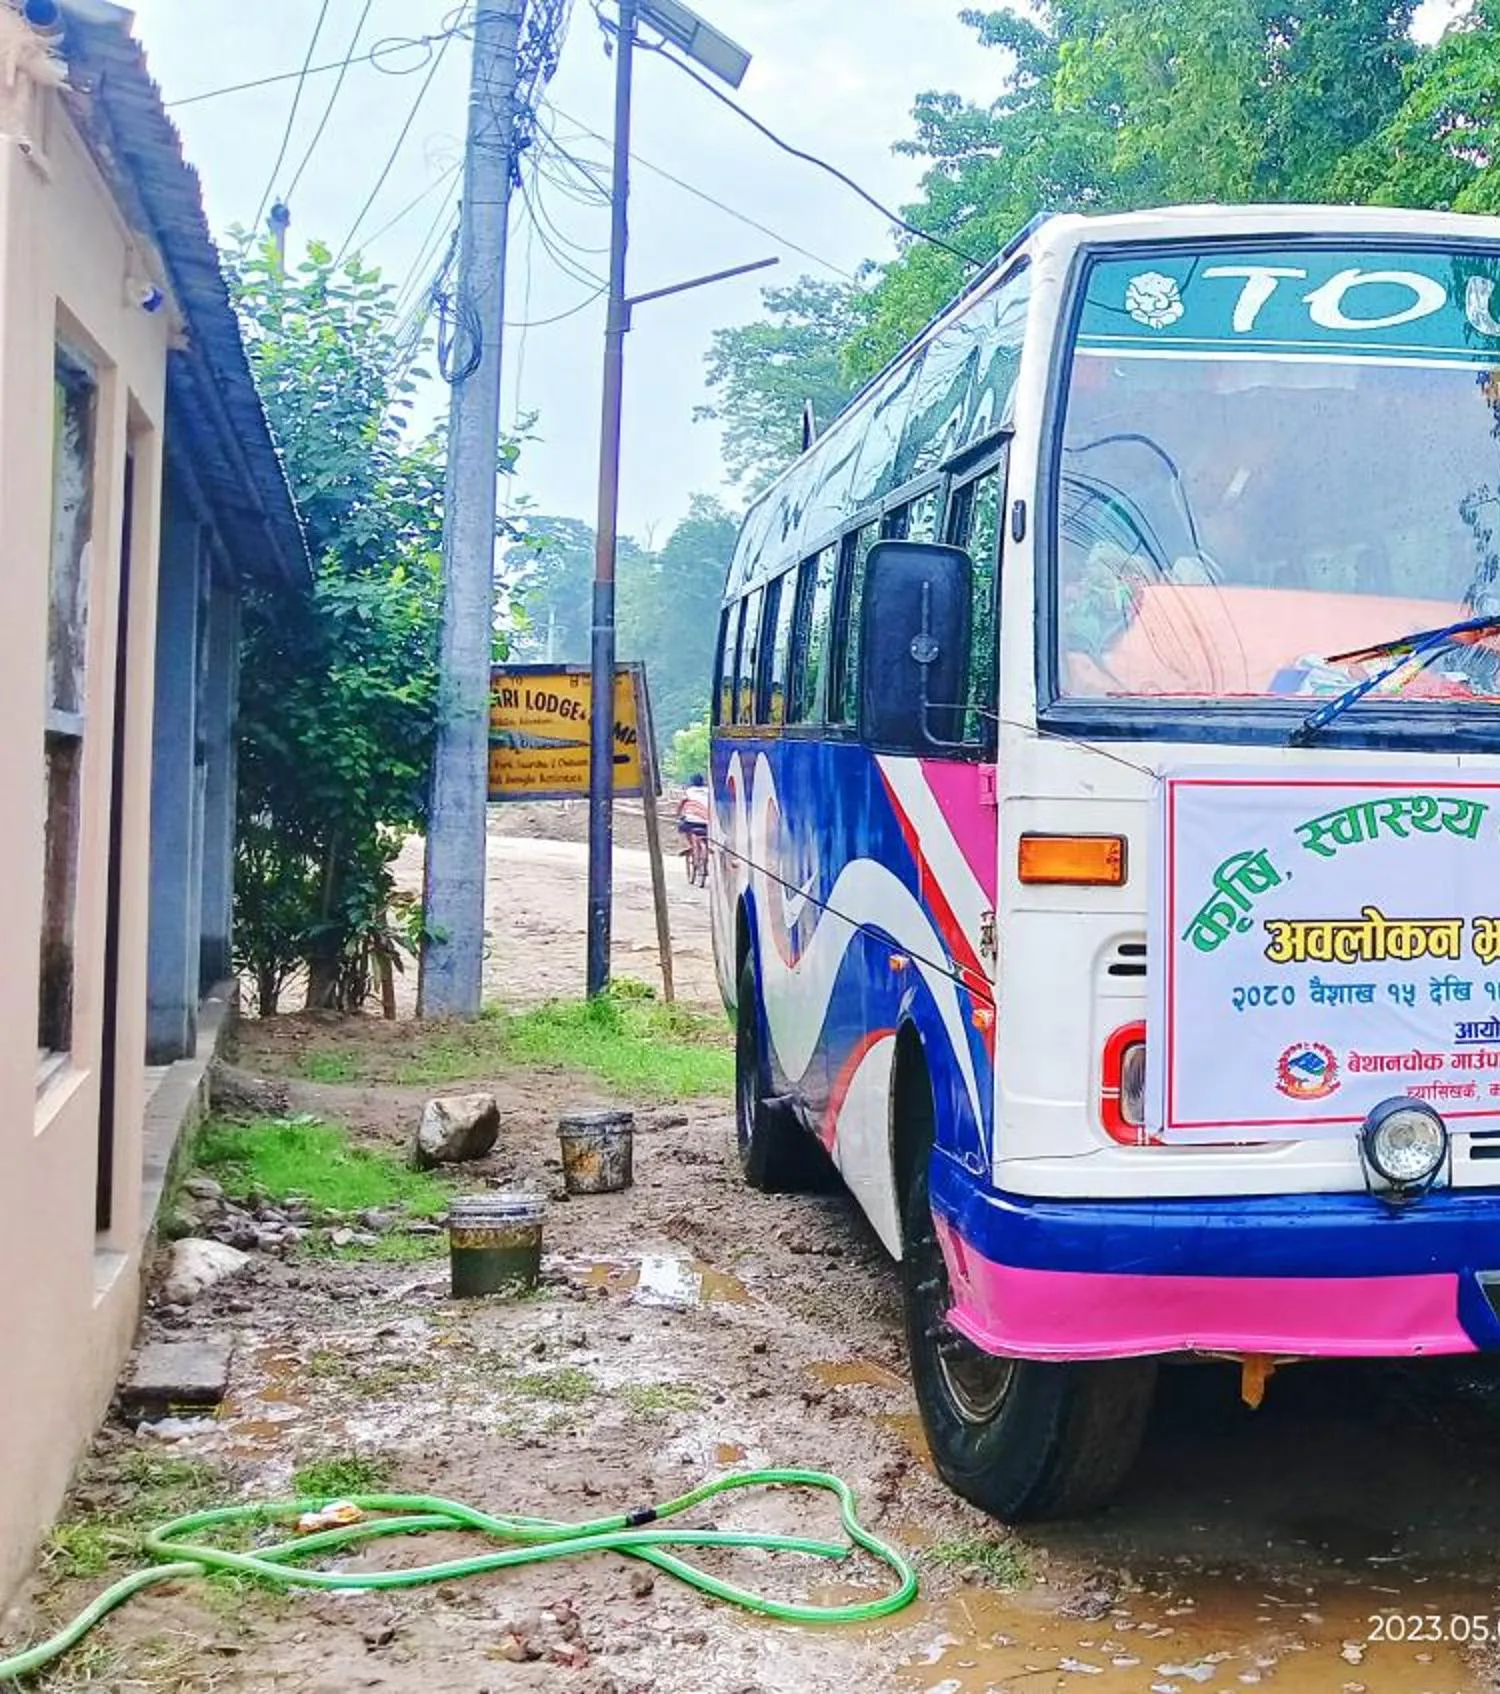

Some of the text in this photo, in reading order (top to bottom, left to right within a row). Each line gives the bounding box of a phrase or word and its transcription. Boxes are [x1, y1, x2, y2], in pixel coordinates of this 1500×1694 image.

[1294, 796, 1489, 857] स्वास्थ्य
[1264, 906, 1464, 964] अवलोकन
[1232, 985, 1296, 1011] २०८०
[1309, 976, 1376, 1006] वैशाख
[1387, 982, 1417, 1008] १५
[1429, 976, 1473, 1006] देखि
